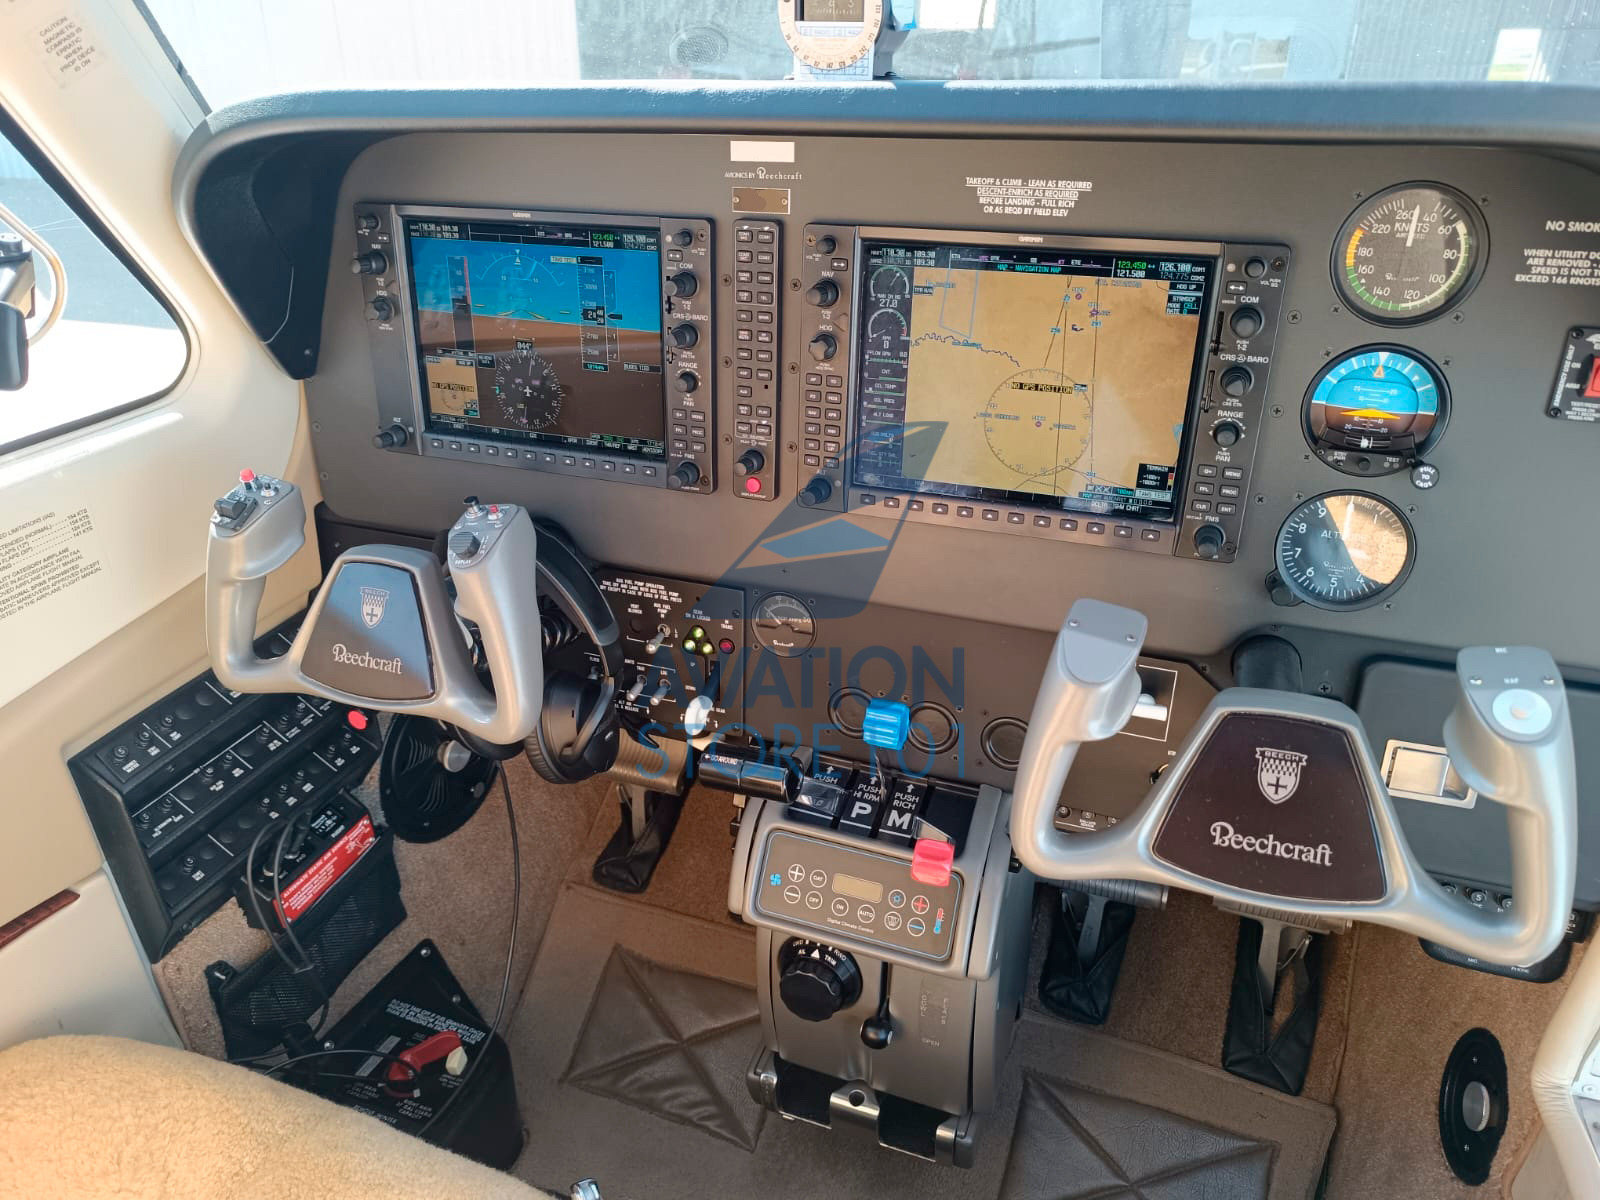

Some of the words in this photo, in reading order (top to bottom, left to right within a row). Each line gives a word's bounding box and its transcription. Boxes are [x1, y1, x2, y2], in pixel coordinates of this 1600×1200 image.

[756, 166, 802, 180] Beechcraft
[965, 177, 995, 186] TAKEOFF
[995, 178, 1001, 186] &
[1001, 178, 1022, 187] CLIMB
[1028, 179, 1046, 187] LEAN
[1047, 180, 1057, 188] AS
[1057, 181, 1093, 190] REQUIRED
[1034, 189, 1043, 197] AS
[1045, 189, 1079, 198] REQUIRED
[979, 197, 1003, 205] BEFORE
[1004, 198, 1035, 207] LANDING
[1041, 199, 1056, 208] FULL
[1058, 200, 1075, 208] RICH
[983, 206, 993, 214] OR
[1004, 207, 1022, 215] REQD
[1033, 208, 1051, 216] FIELD
[1052, 209, 1069, 217] ELEV
[1395, 210, 1415, 220] 260
[1423, 212, 1438, 222] 40
[1371, 223, 1390, 234] 220
[1393, 222, 1430, 233] KNTS
[1437, 225, 1452, 235] 60
[1545, 220, 1566, 231] NO
[1357, 247, 1374, 257] 180
[1442, 250, 1457, 260] 80
[1523, 248, 1553, 257] WHEN
[1554, 249, 1588, 259] UTILITY
[1117, 260, 1147, 270] 123.450
[1160, 262, 1192, 272] 126.100
[1526, 257, 1545, 265] ARE
[1546, 258, 1591, 267] REMOVED
[1116, 269, 1146, 278] 121.500
[1160, 271, 1189, 281] 124.775
[1357, 264, 1375, 274] 160
[1428, 273, 1446, 284] 100
[1530, 266, 1558, 275] SPEED
[1560, 267, 1569, 275] IS
[1570, 268, 1592, 276] NOT
[1514, 274, 1549, 283] EXCEED
[1551, 276, 1568, 284] 166
[1240, 295, 1259, 303] COM
[1372, 287, 1391, 297] 140
[1403, 289, 1421, 300] 120
[1220, 353, 1236, 361] CRS
[1247, 355, 1269, 364] BARO
[1011, 382, 1020, 390] NO
[1022, 383, 1035, 391] GPS
[1037, 384, 1073, 395] POSITION
[1217, 409, 1244, 419] RANGE
[1215, 455, 1231, 463] PAN
[1317, 508, 1327, 518] 9
[1204, 515, 1220, 523] FMS
[1298, 523, 1307, 534] 8
[1294, 547, 1302, 558] 7
[17, 561, 54, 581] ACCORDANCE
[1306, 566, 1315, 577] 6
[1329, 577, 1338, 588] 5
[1355, 573, 1365, 584] 4
[332, 643, 404, 675] Beechcraft
[1264, 750, 1300, 761] BEECH
[813, 773, 839, 785] PUSH
[857, 784, 882, 794] PUSH
[863, 792, 880, 802] RPM
[894, 792, 919, 803] PUSH
[850, 801, 872, 818] P
[893, 799, 916, 810] RICH
[887, 809, 912, 830] M
[1210, 821, 1334, 867] Beechcraft
[859, 910, 874, 918] AUTO
